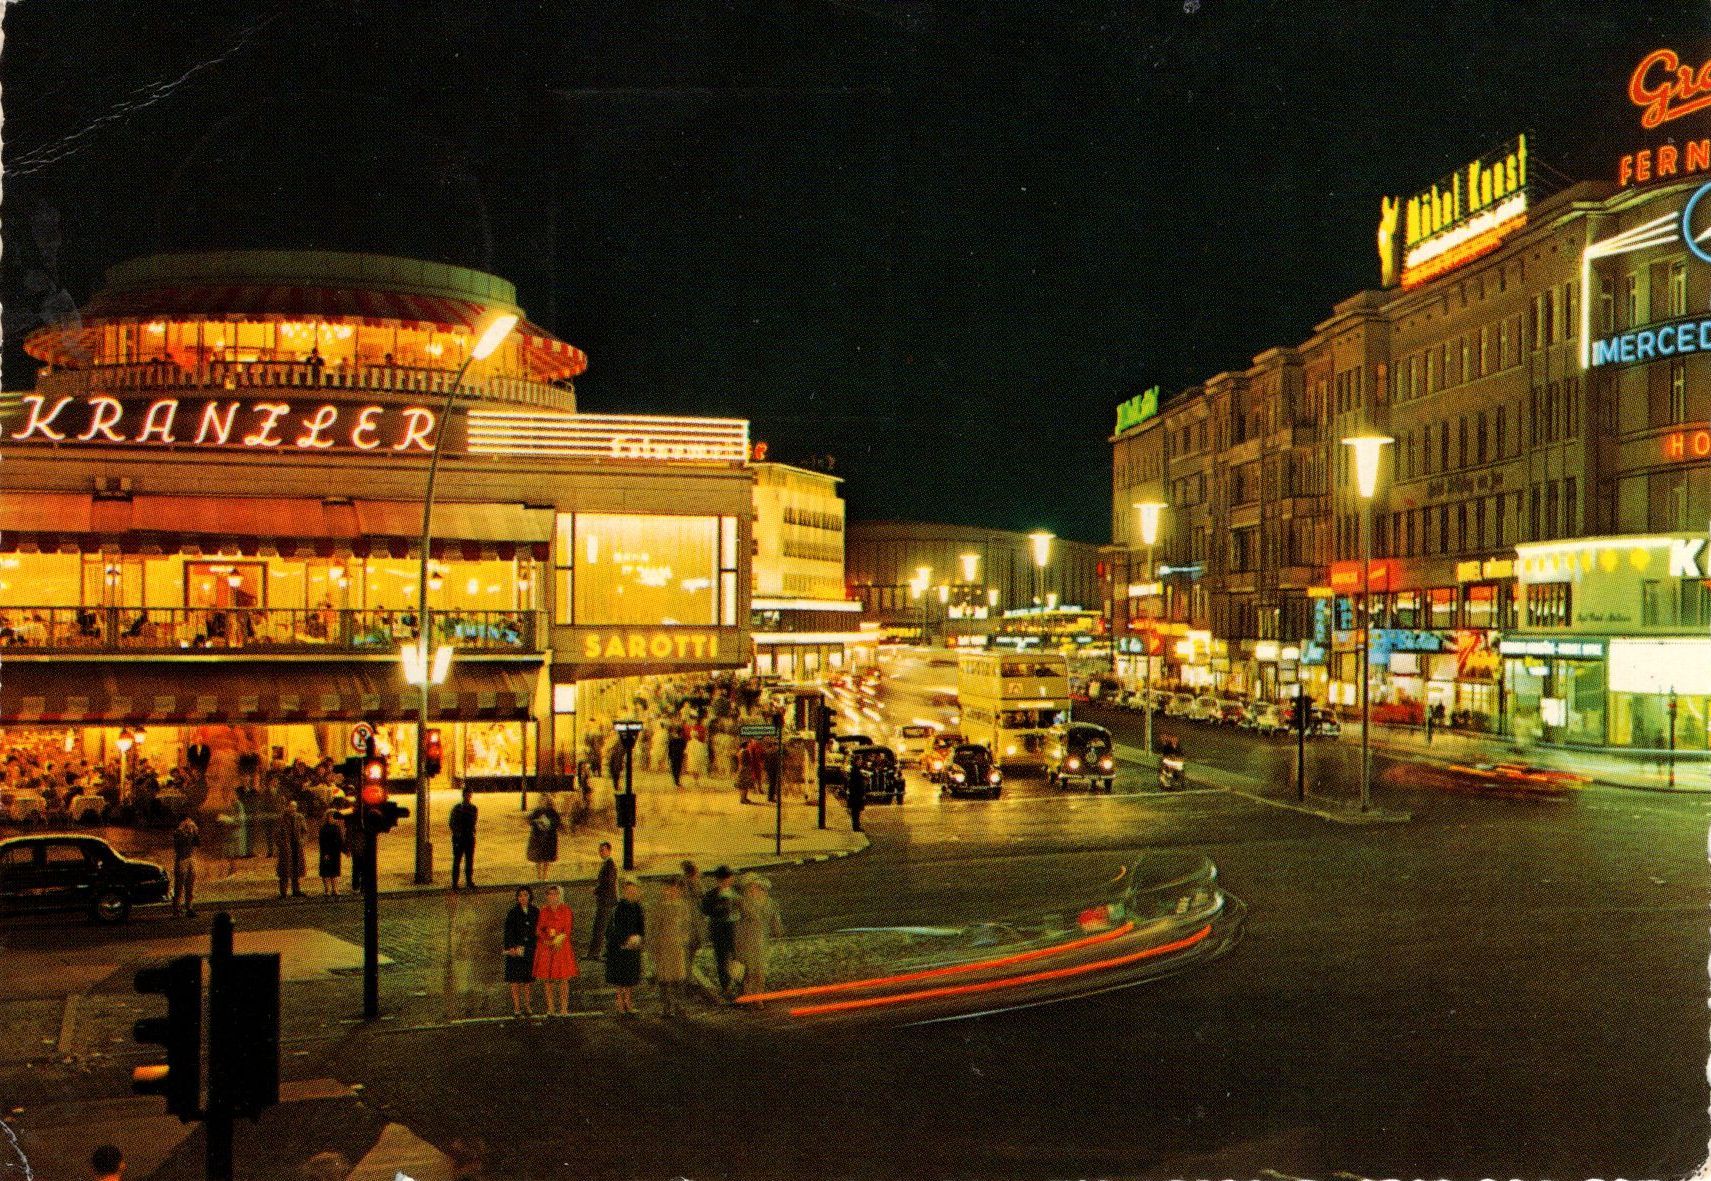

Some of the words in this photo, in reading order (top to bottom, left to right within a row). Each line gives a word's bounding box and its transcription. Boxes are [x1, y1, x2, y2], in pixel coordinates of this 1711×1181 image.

[1619, 139, 1711, 187] FERN
[11, 395, 437, 452] KRANZLER
[1671, 430, 1711, 457] HO
[1669, 538, 1711, 577] K
[584, 631, 718, 659] SAROTTI
